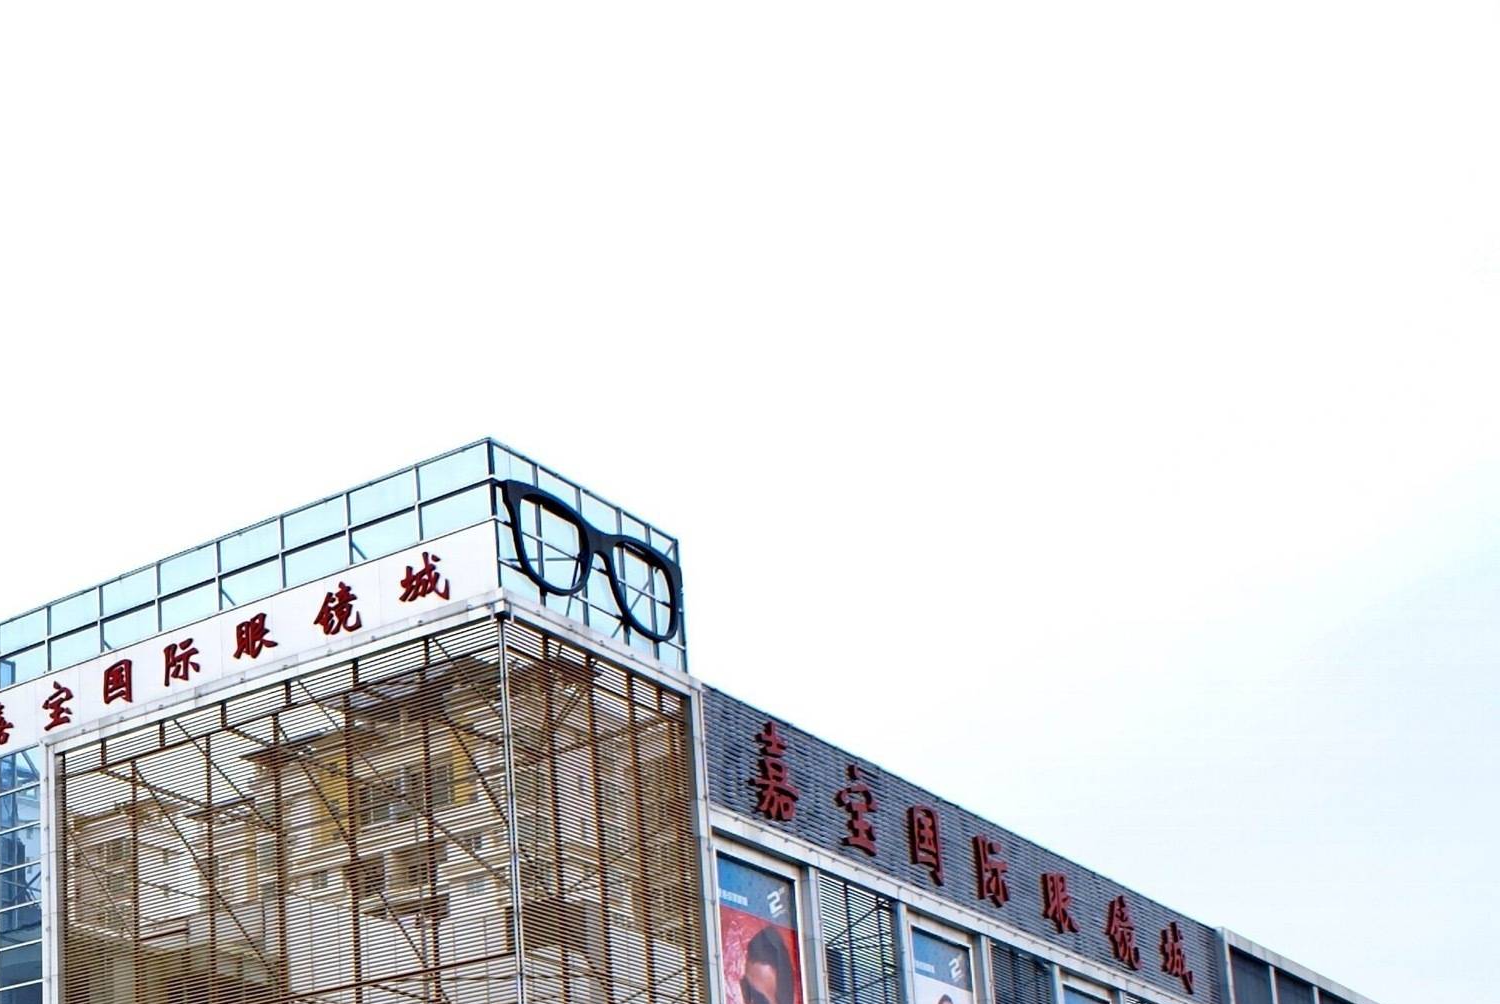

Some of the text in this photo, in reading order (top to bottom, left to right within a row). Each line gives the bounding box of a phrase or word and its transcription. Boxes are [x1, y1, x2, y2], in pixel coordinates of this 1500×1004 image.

[746, 720, 1193, 994] 嘉宝国际眼镜城
